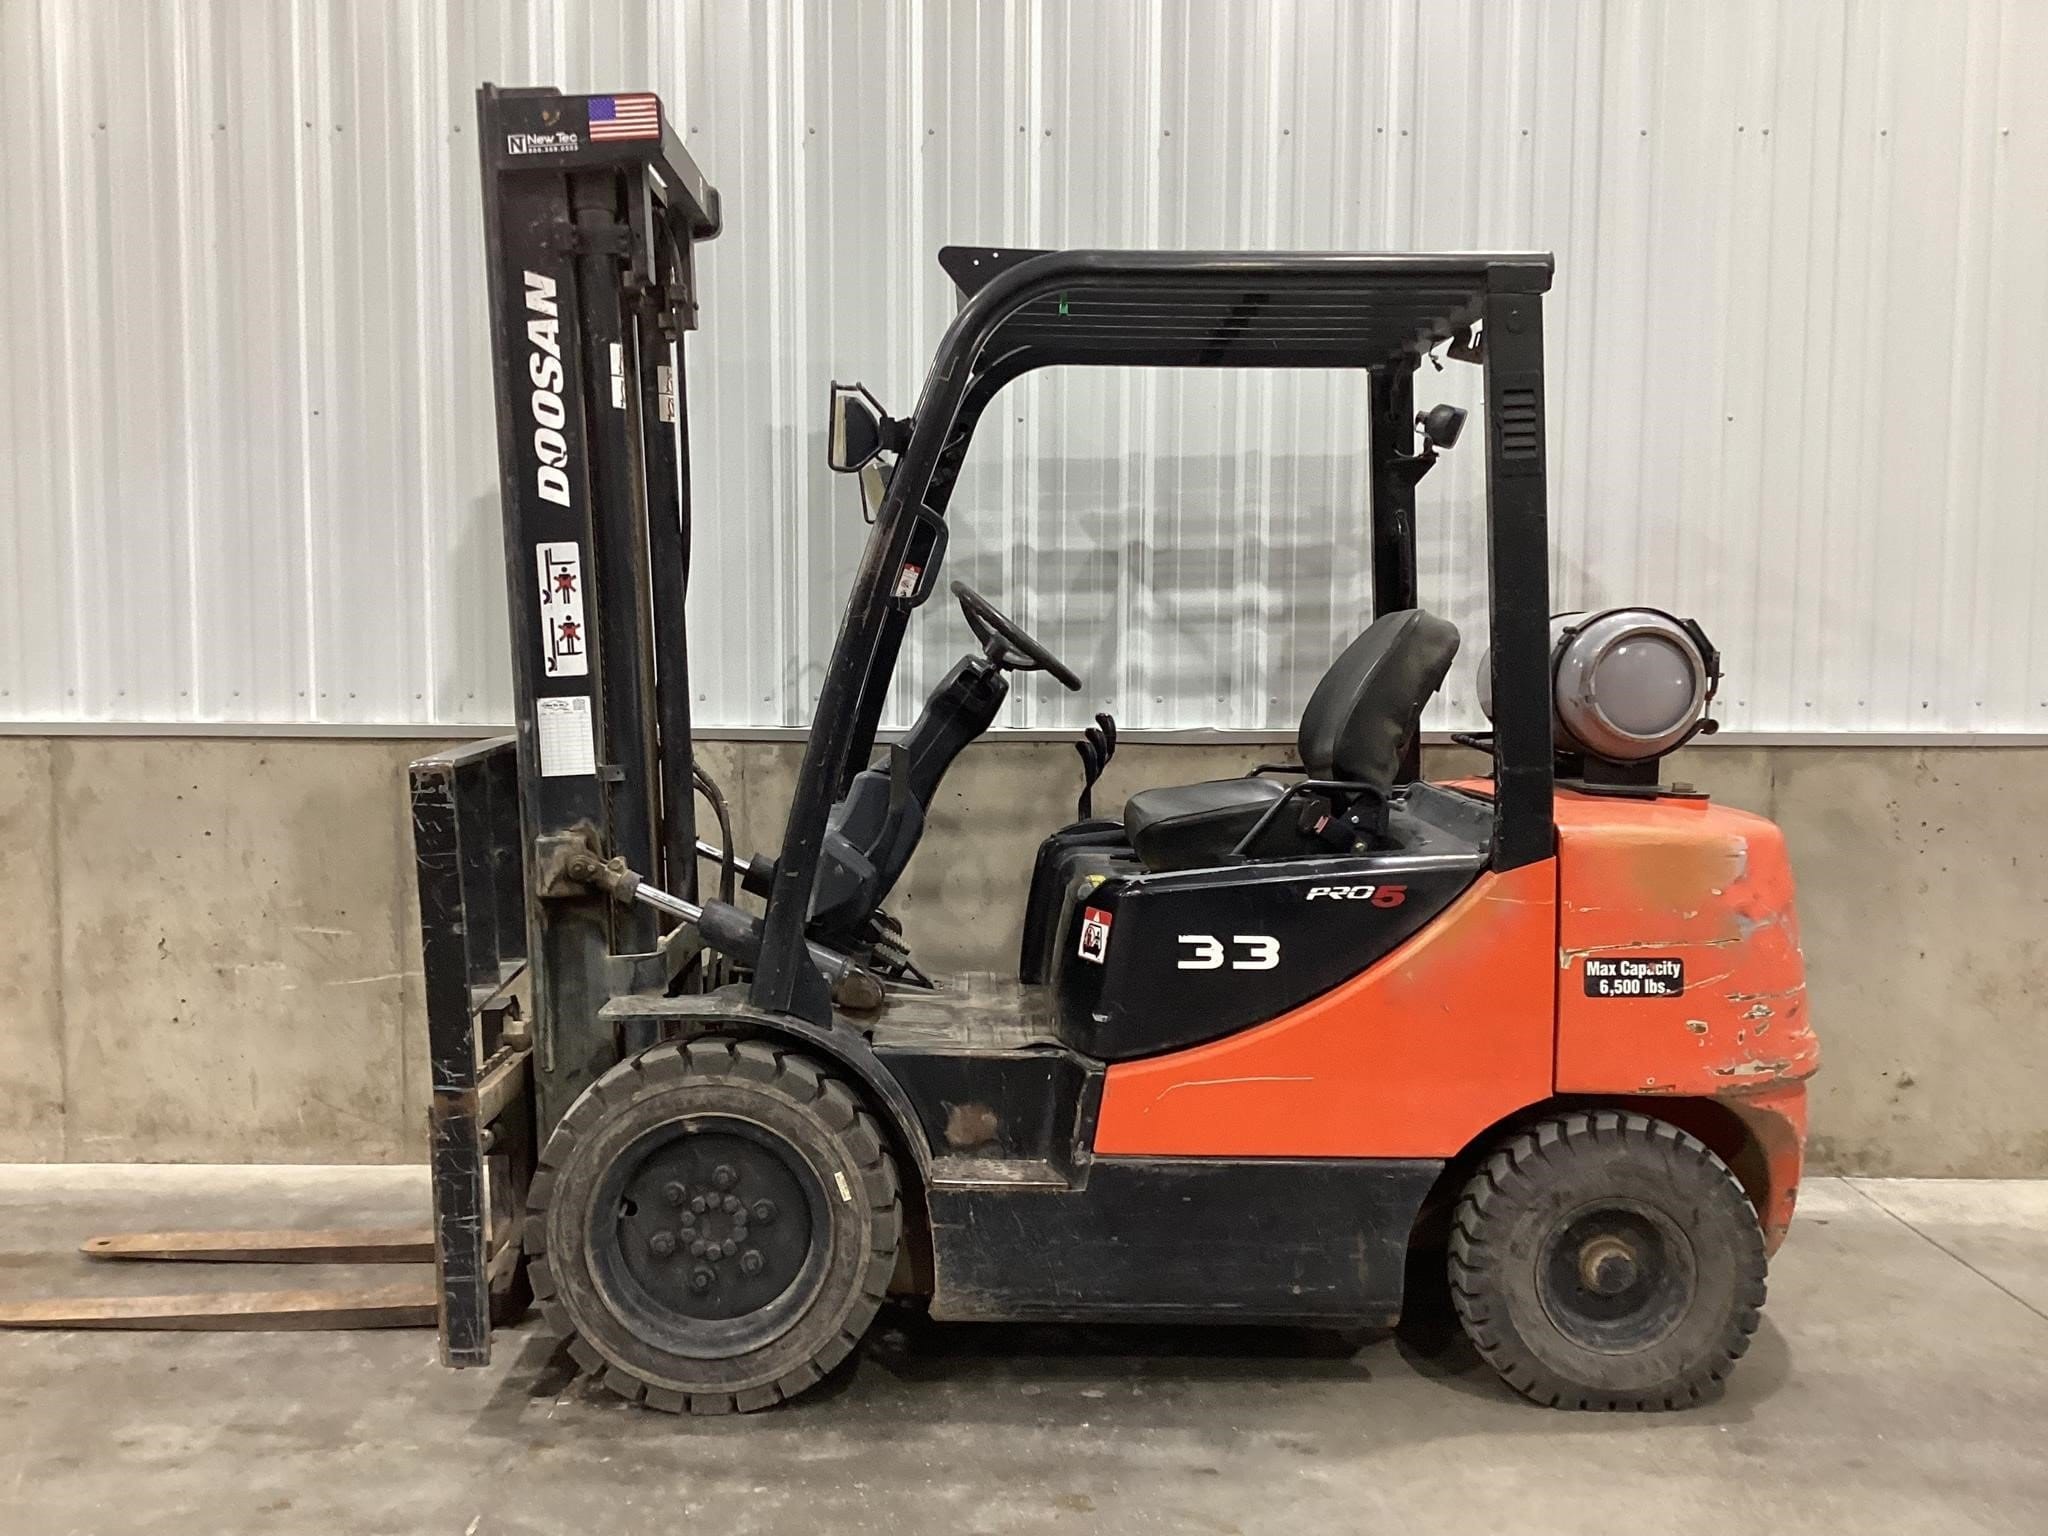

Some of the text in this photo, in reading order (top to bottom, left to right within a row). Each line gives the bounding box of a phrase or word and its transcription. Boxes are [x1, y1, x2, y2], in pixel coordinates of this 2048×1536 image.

[527, 133, 554, 144] New
[556, 132, 577, 142] Tec
[523, 270, 571, 508] DOOSAN
[1306, 885, 1408, 908] PRO5
[1177, 934, 1281, 970] 33
[1587, 961, 1616, 976] Max
[1599, 979, 1671, 996] 6,500 lbs.
